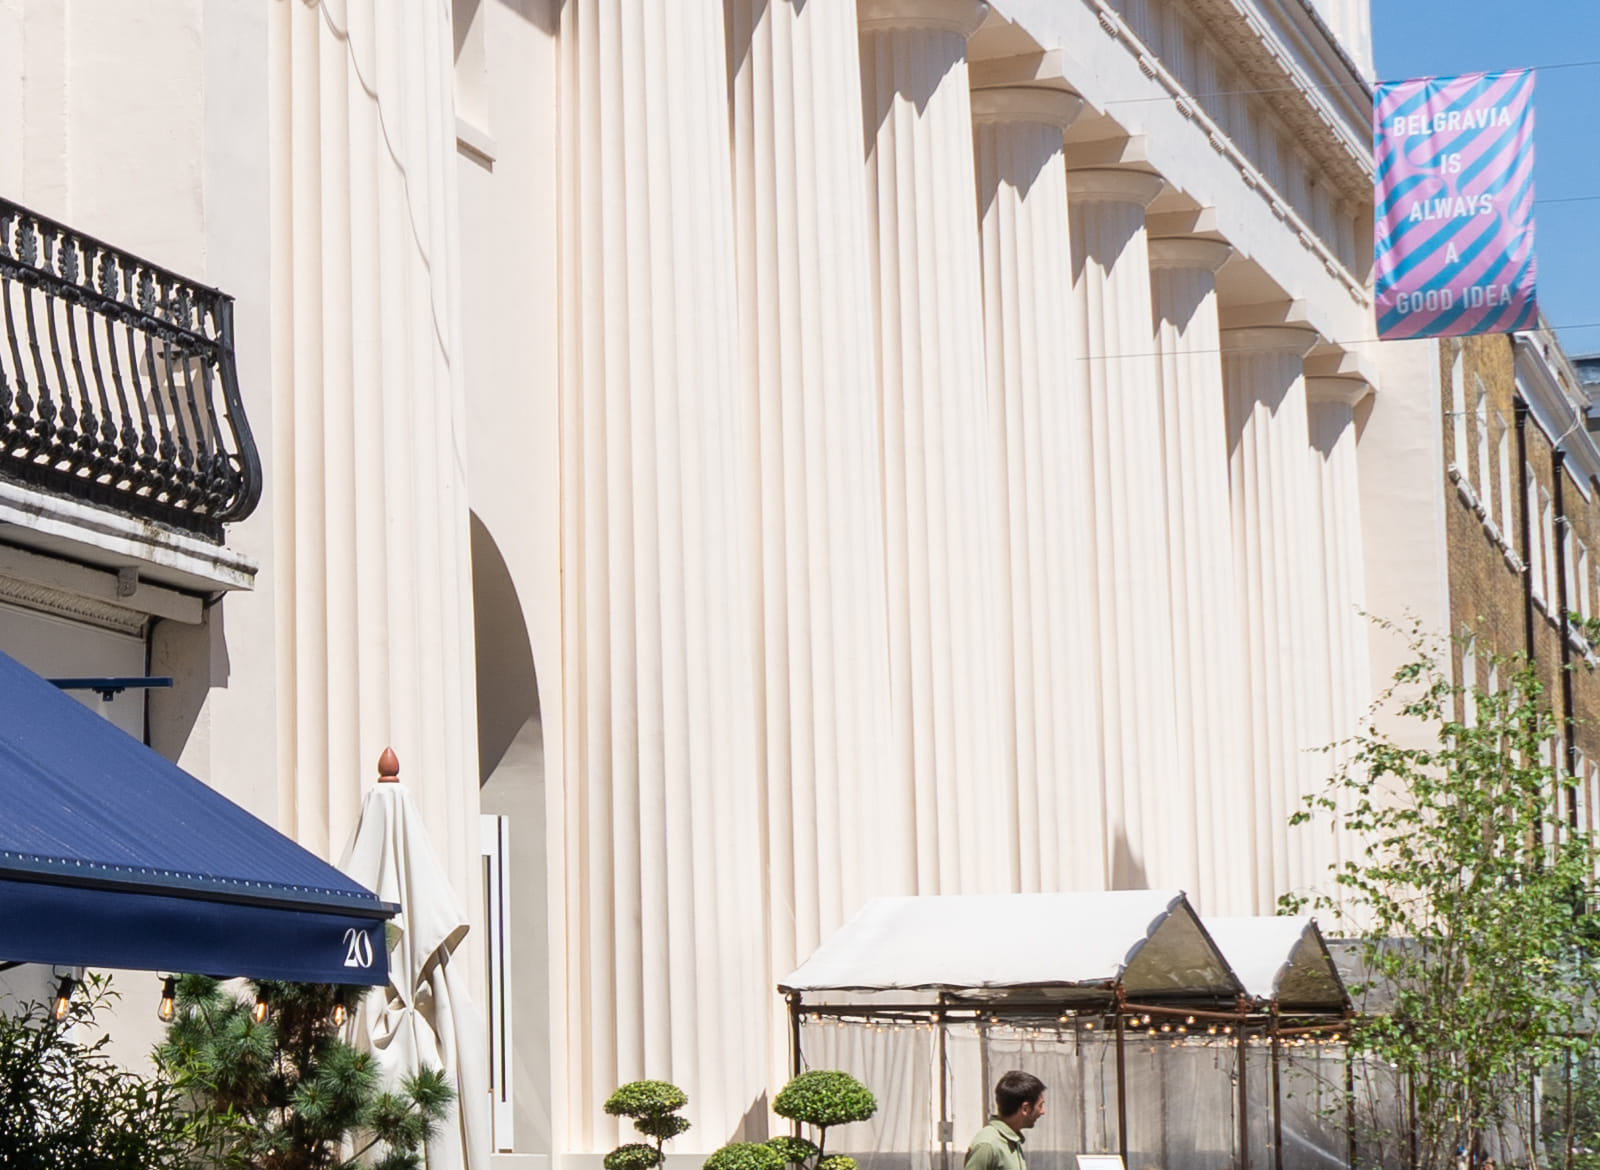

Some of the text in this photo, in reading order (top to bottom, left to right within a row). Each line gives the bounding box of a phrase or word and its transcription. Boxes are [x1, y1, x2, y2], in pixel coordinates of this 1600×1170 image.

[1393, 106, 1512, 137] BELGRAVIA
[1440, 154, 1462, 174] IS
[1409, 193, 1494, 222] ALWAYS
[1444, 242, 1460, 263] A
[1396, 284, 1512, 314] GOOD IDEA
[342, 927, 374, 968] 20
